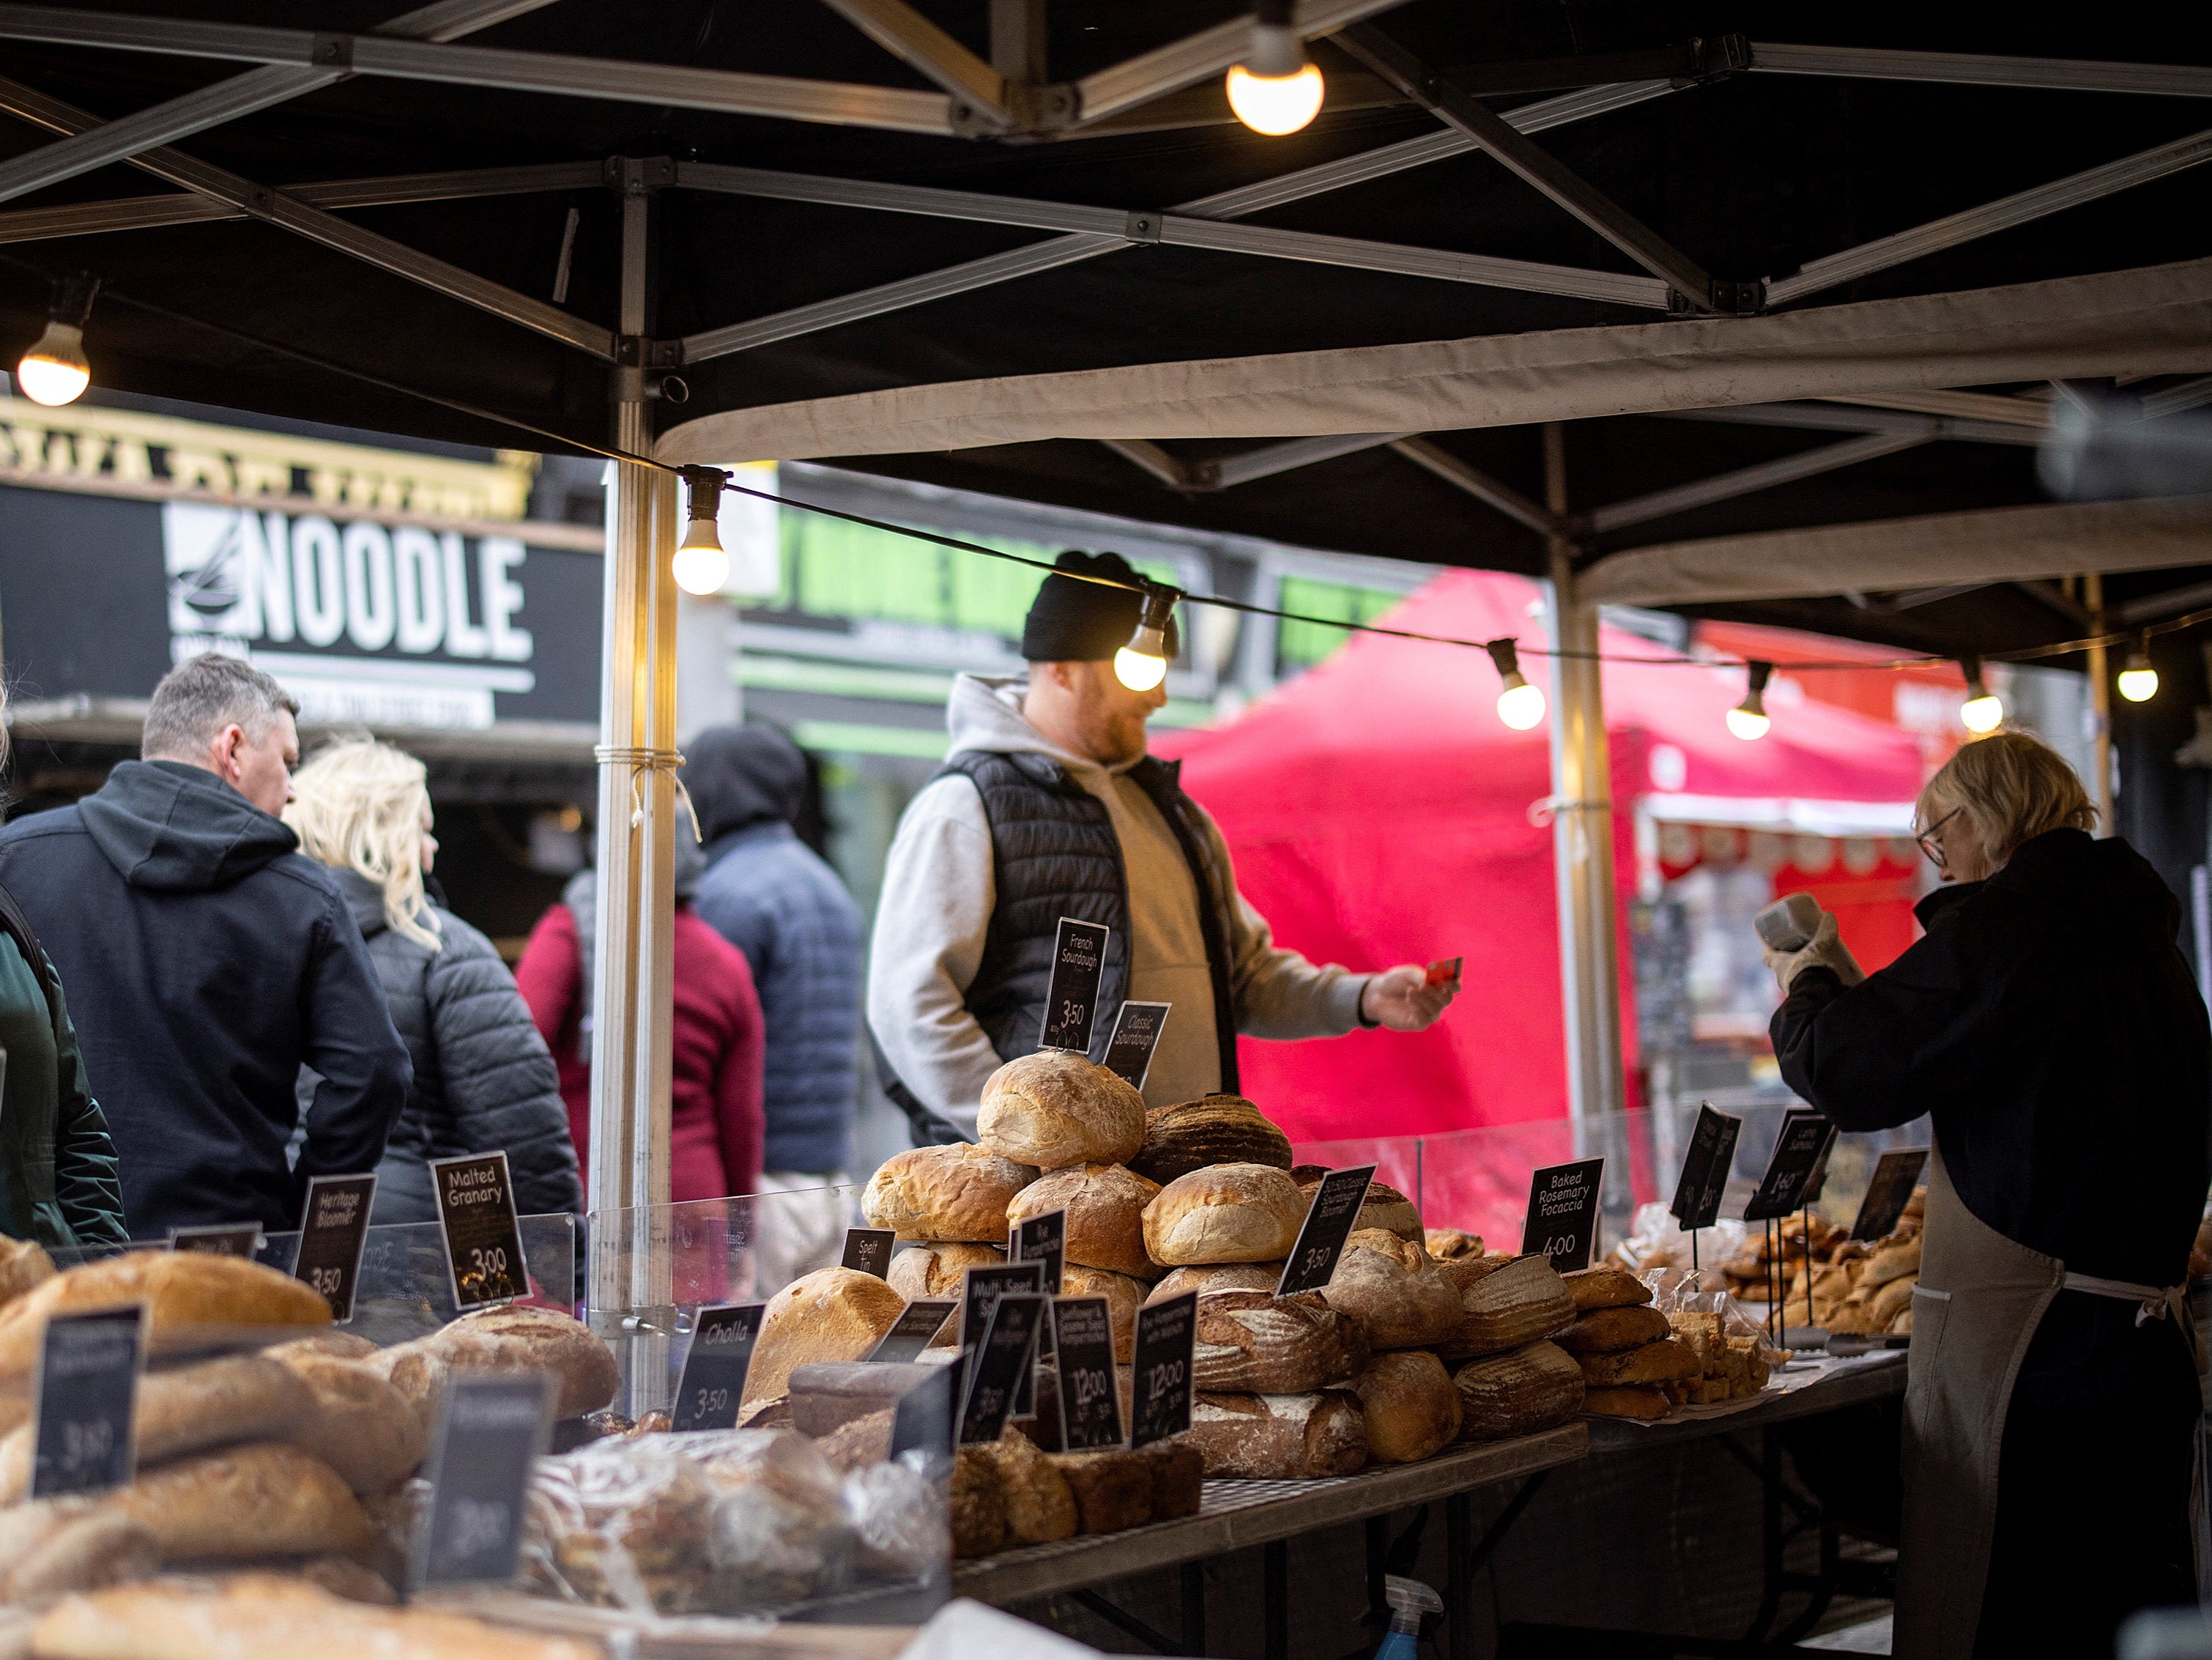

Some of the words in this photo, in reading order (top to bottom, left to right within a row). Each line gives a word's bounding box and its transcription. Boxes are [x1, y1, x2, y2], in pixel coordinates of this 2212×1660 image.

[244, 511, 534, 662] NOODLE
[1070, 933, 1094, 951] French
[1061, 948, 1097, 971] Sourdough
[1061, 999, 1085, 1029] 3.50
[1128, 1014, 1153, 1030] Classic
[1115, 1030, 1154, 1051] Sourdough
[449, 1166, 496, 1188] Malted
[1551, 1171, 1583, 1188] Baked
[448, 1186, 502, 1207] Granary
[1539, 1185, 1590, 1204] Rosemary
[1541, 1198, 1583, 1217] Focaccia
[858, 1240, 878, 1256] Spelt
[1543, 1234, 1576, 1262] 4.00
[860, 1257, 871, 1272] Tin
[1302, 1247, 1331, 1276] 3.50
[695, 1388, 727, 1420] 3.50
